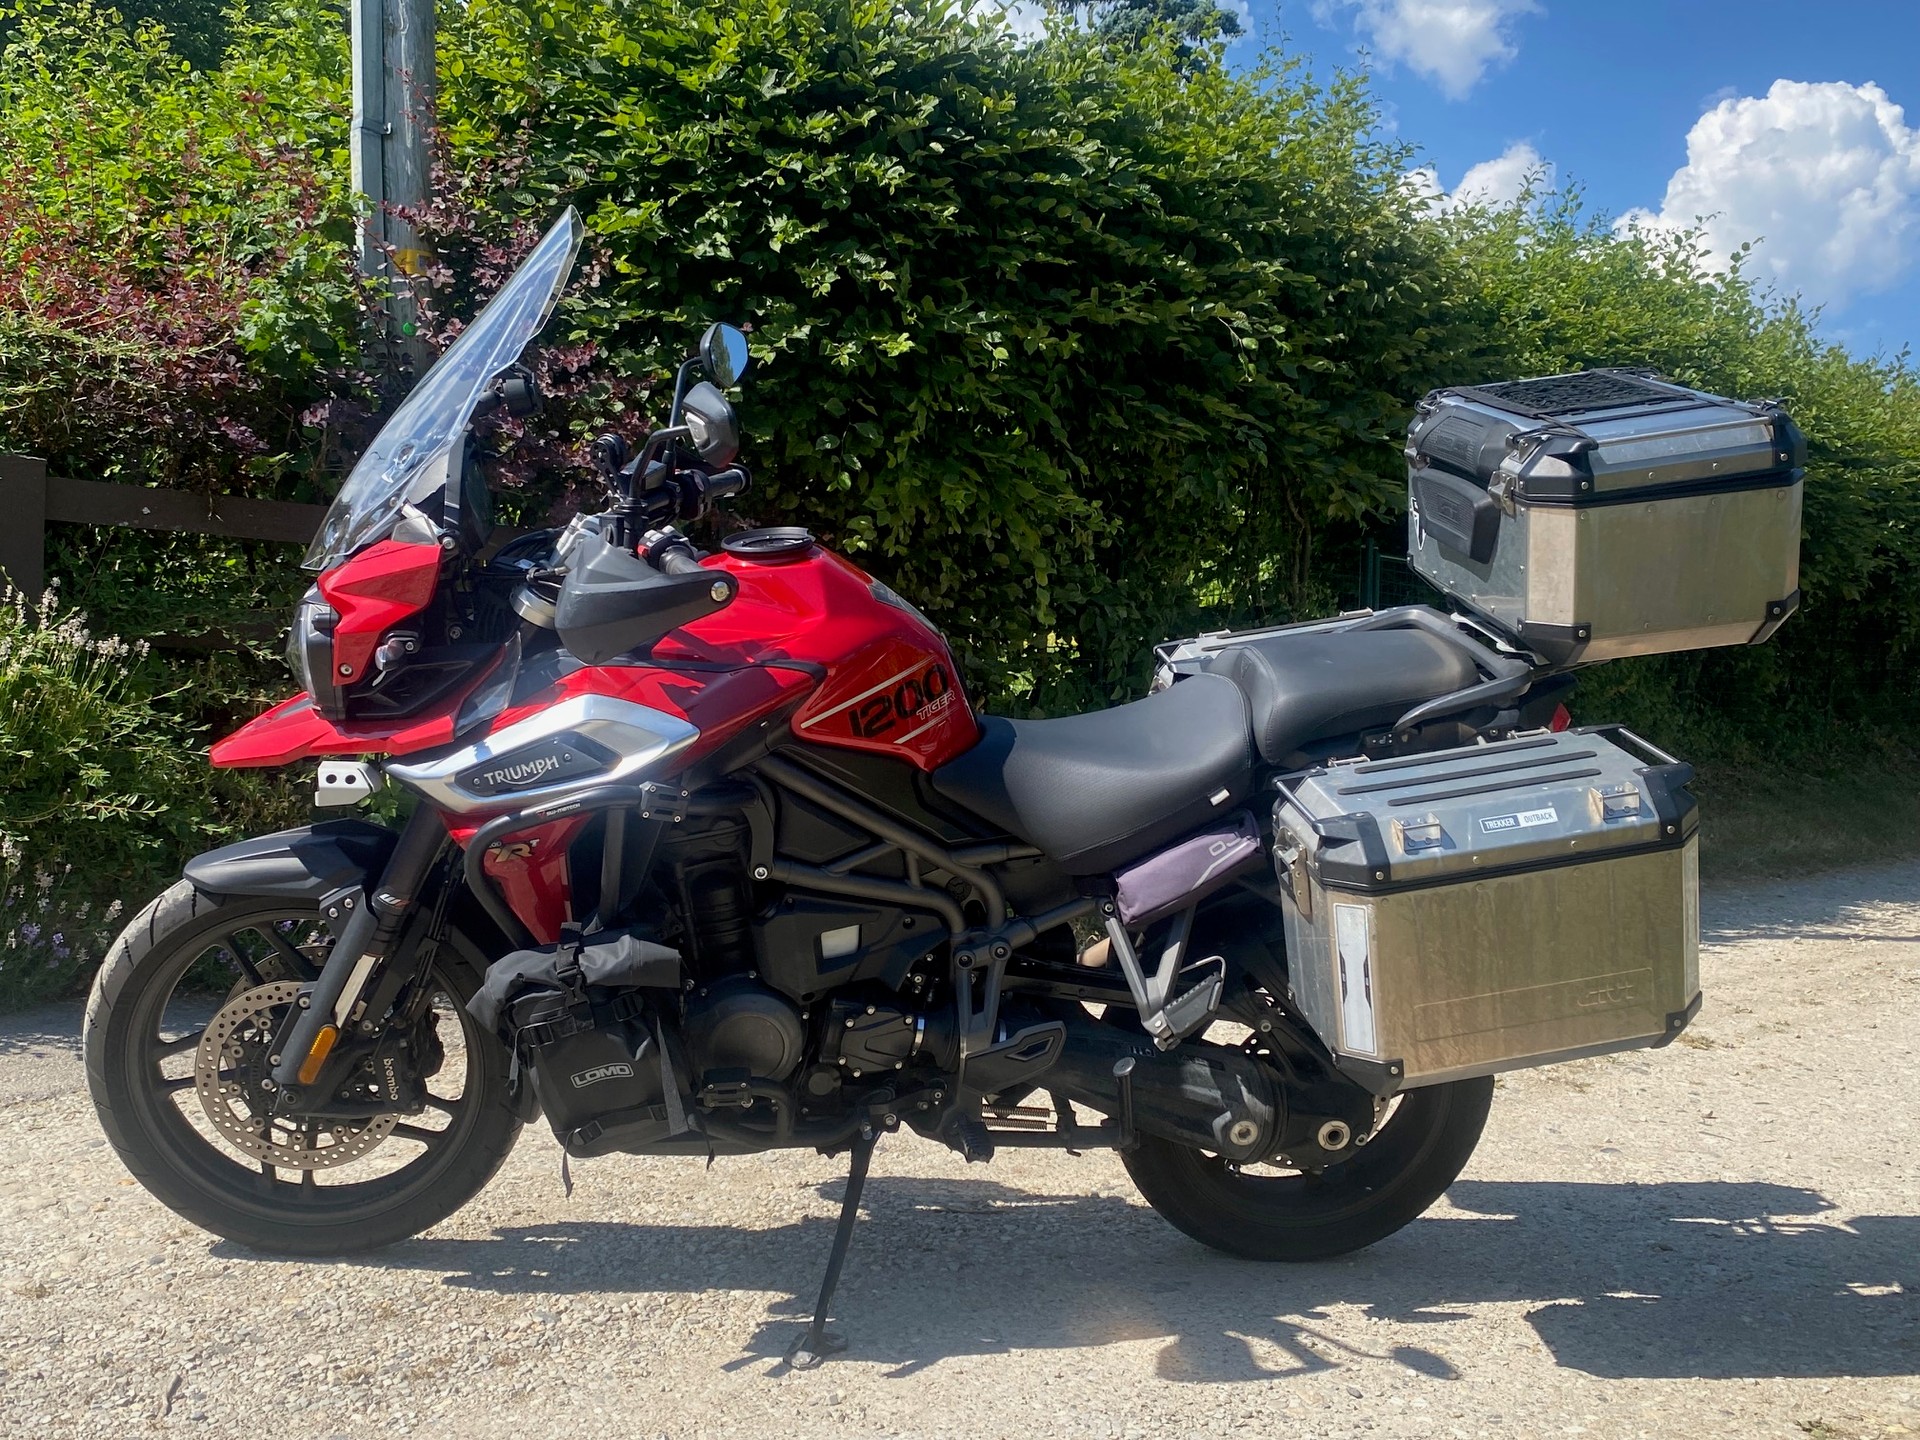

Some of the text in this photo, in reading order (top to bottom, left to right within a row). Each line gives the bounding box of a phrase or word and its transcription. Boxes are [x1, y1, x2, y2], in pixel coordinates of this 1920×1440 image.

[848, 663, 948, 738] 1200
[916, 689, 956, 720] TIGER
[483, 755, 560, 785] TRIUMPH
[1484, 812, 1554, 830] TREKKER OUTBACK
[383, 1057, 399, 1100] brembo
[573, 1065, 630, 1086] LOMO
